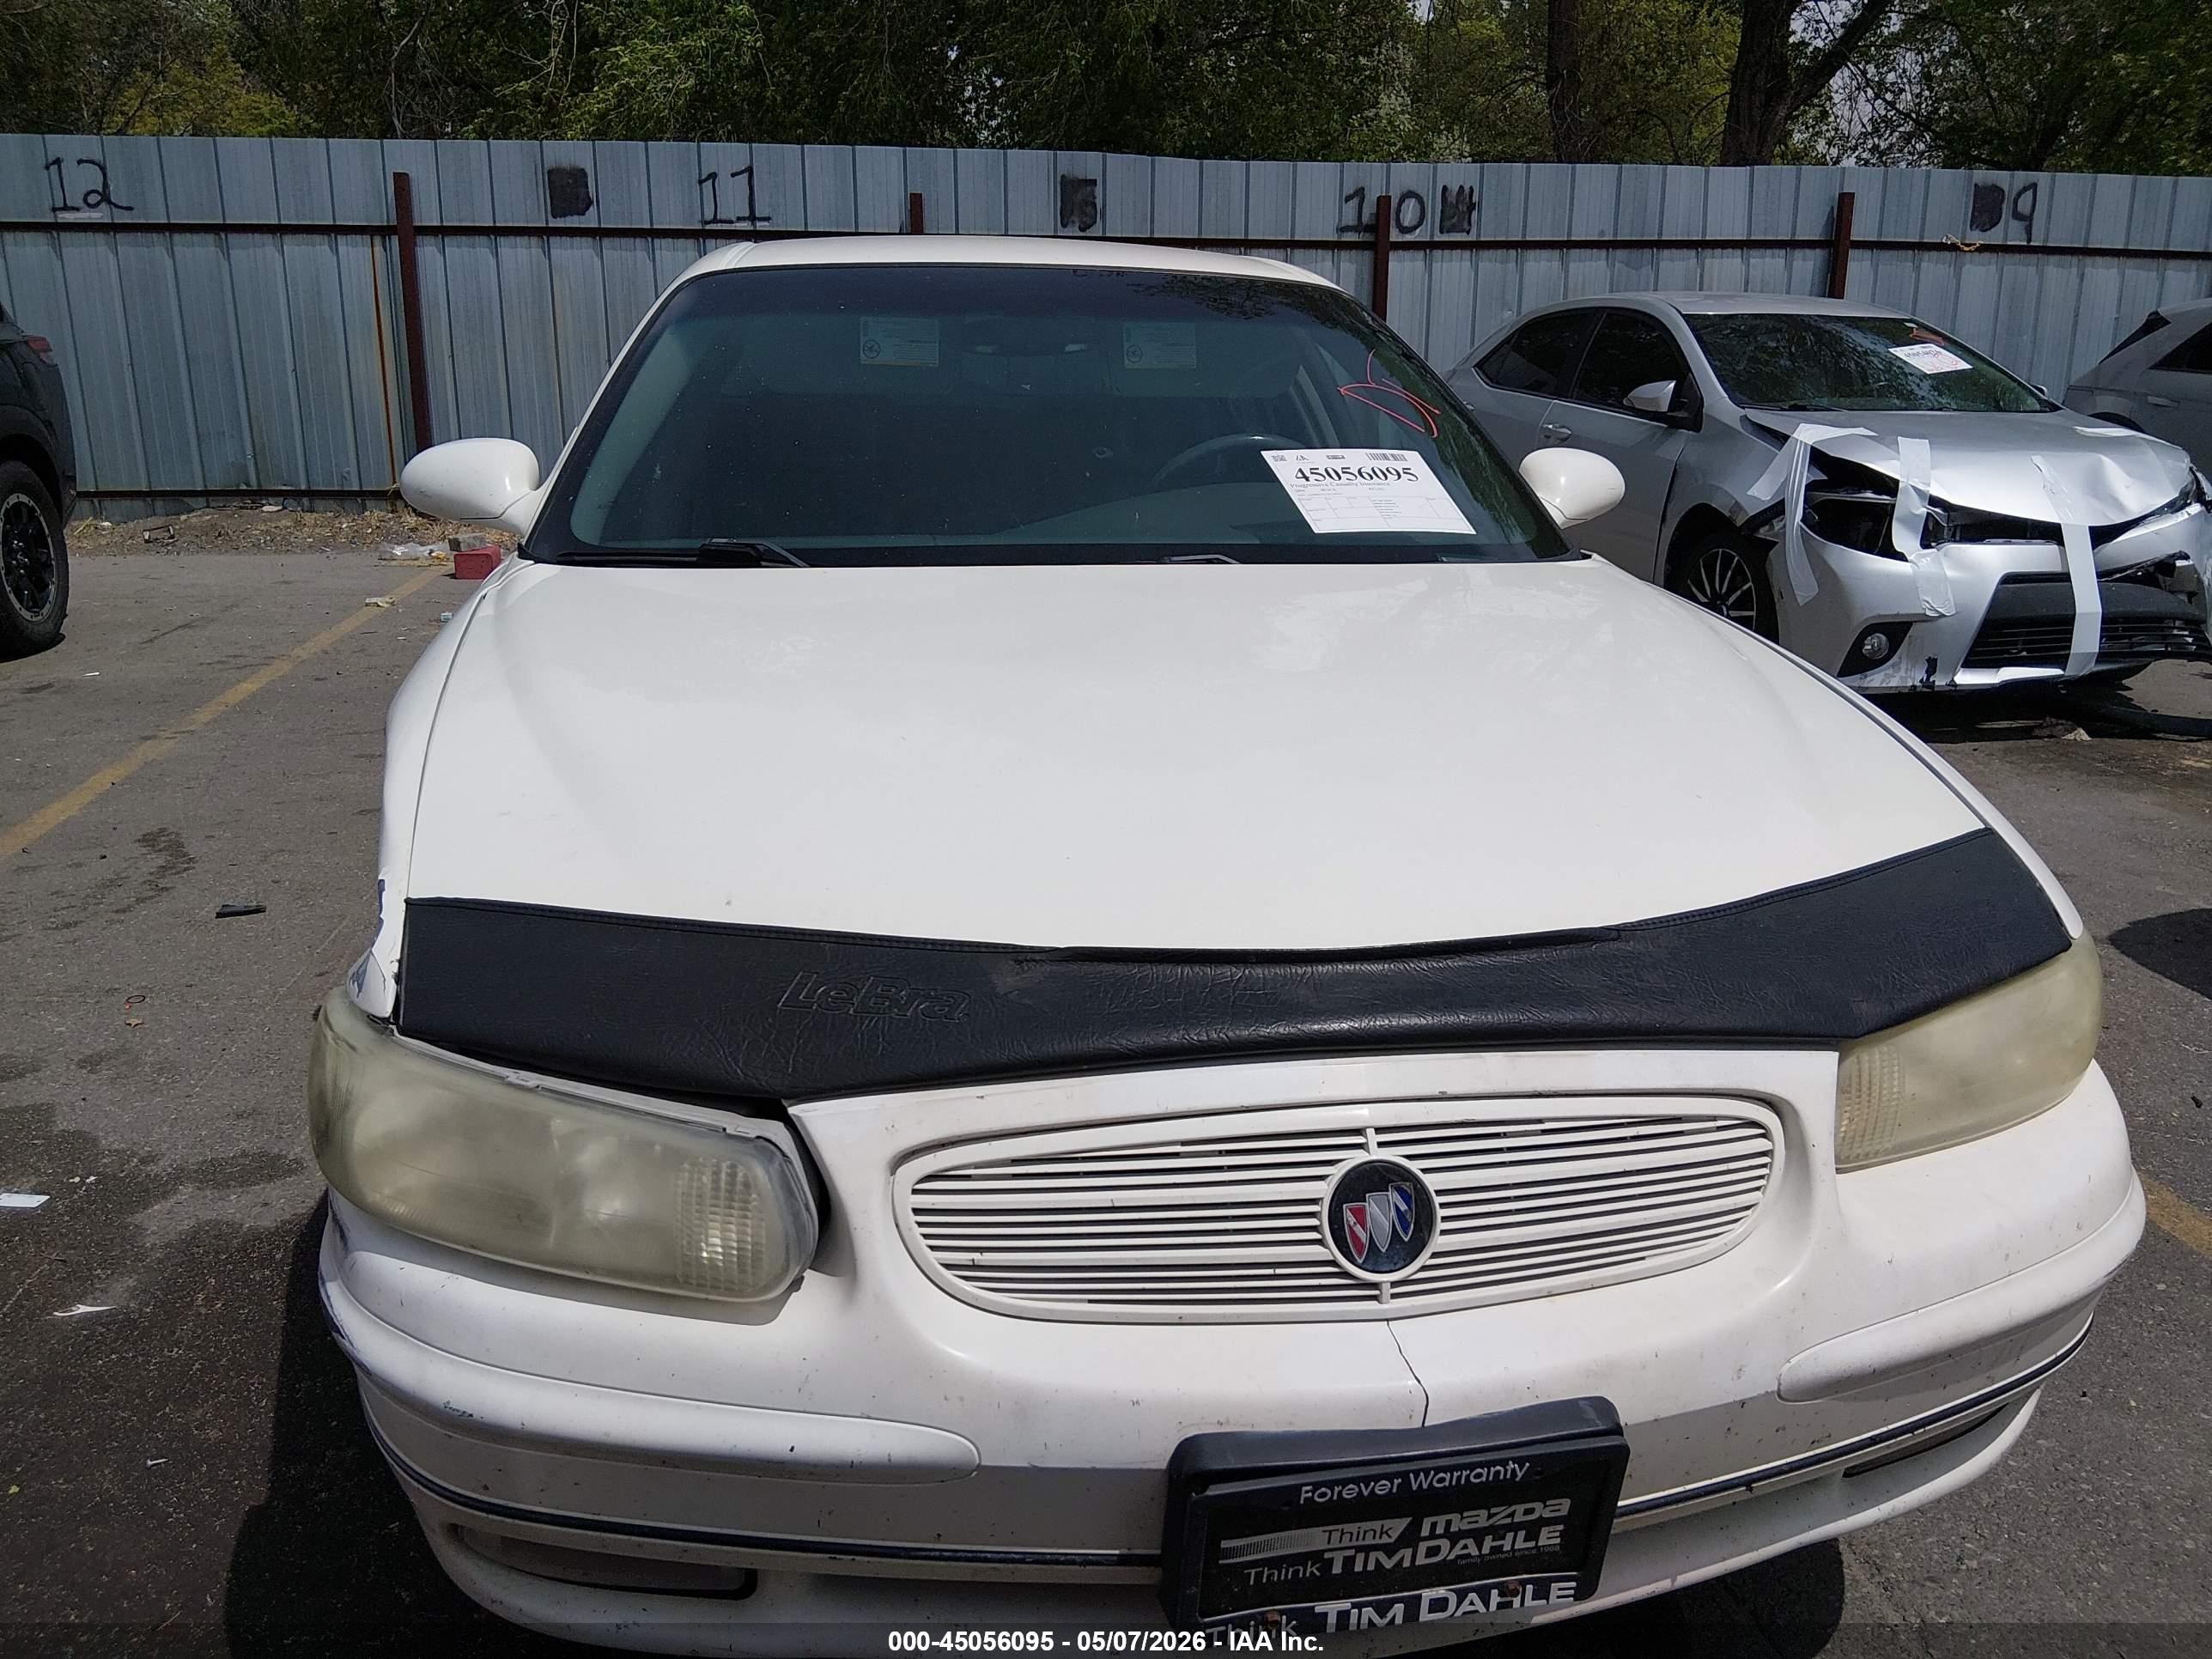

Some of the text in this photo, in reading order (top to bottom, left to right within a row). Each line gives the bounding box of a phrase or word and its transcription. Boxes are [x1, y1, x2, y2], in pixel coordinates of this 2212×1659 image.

[45, 157, 134, 211] 12
[698, 166, 771, 224] 11
[1337, 186, 1425, 234] 10
[2012, 182, 2038, 244] 9
[1295, 465, 1419, 482] 45056095
[777, 971, 971, 1023] LeBra
[1299, 1460, 1530, 1504] Forever Warranty
[1322, 1523, 1394, 1546] Think
[1243, 1559, 1322, 1586] Think
[1314, 1602, 1405, 1634] TIM
[1419, 1582, 1577, 1622] DAHLE
